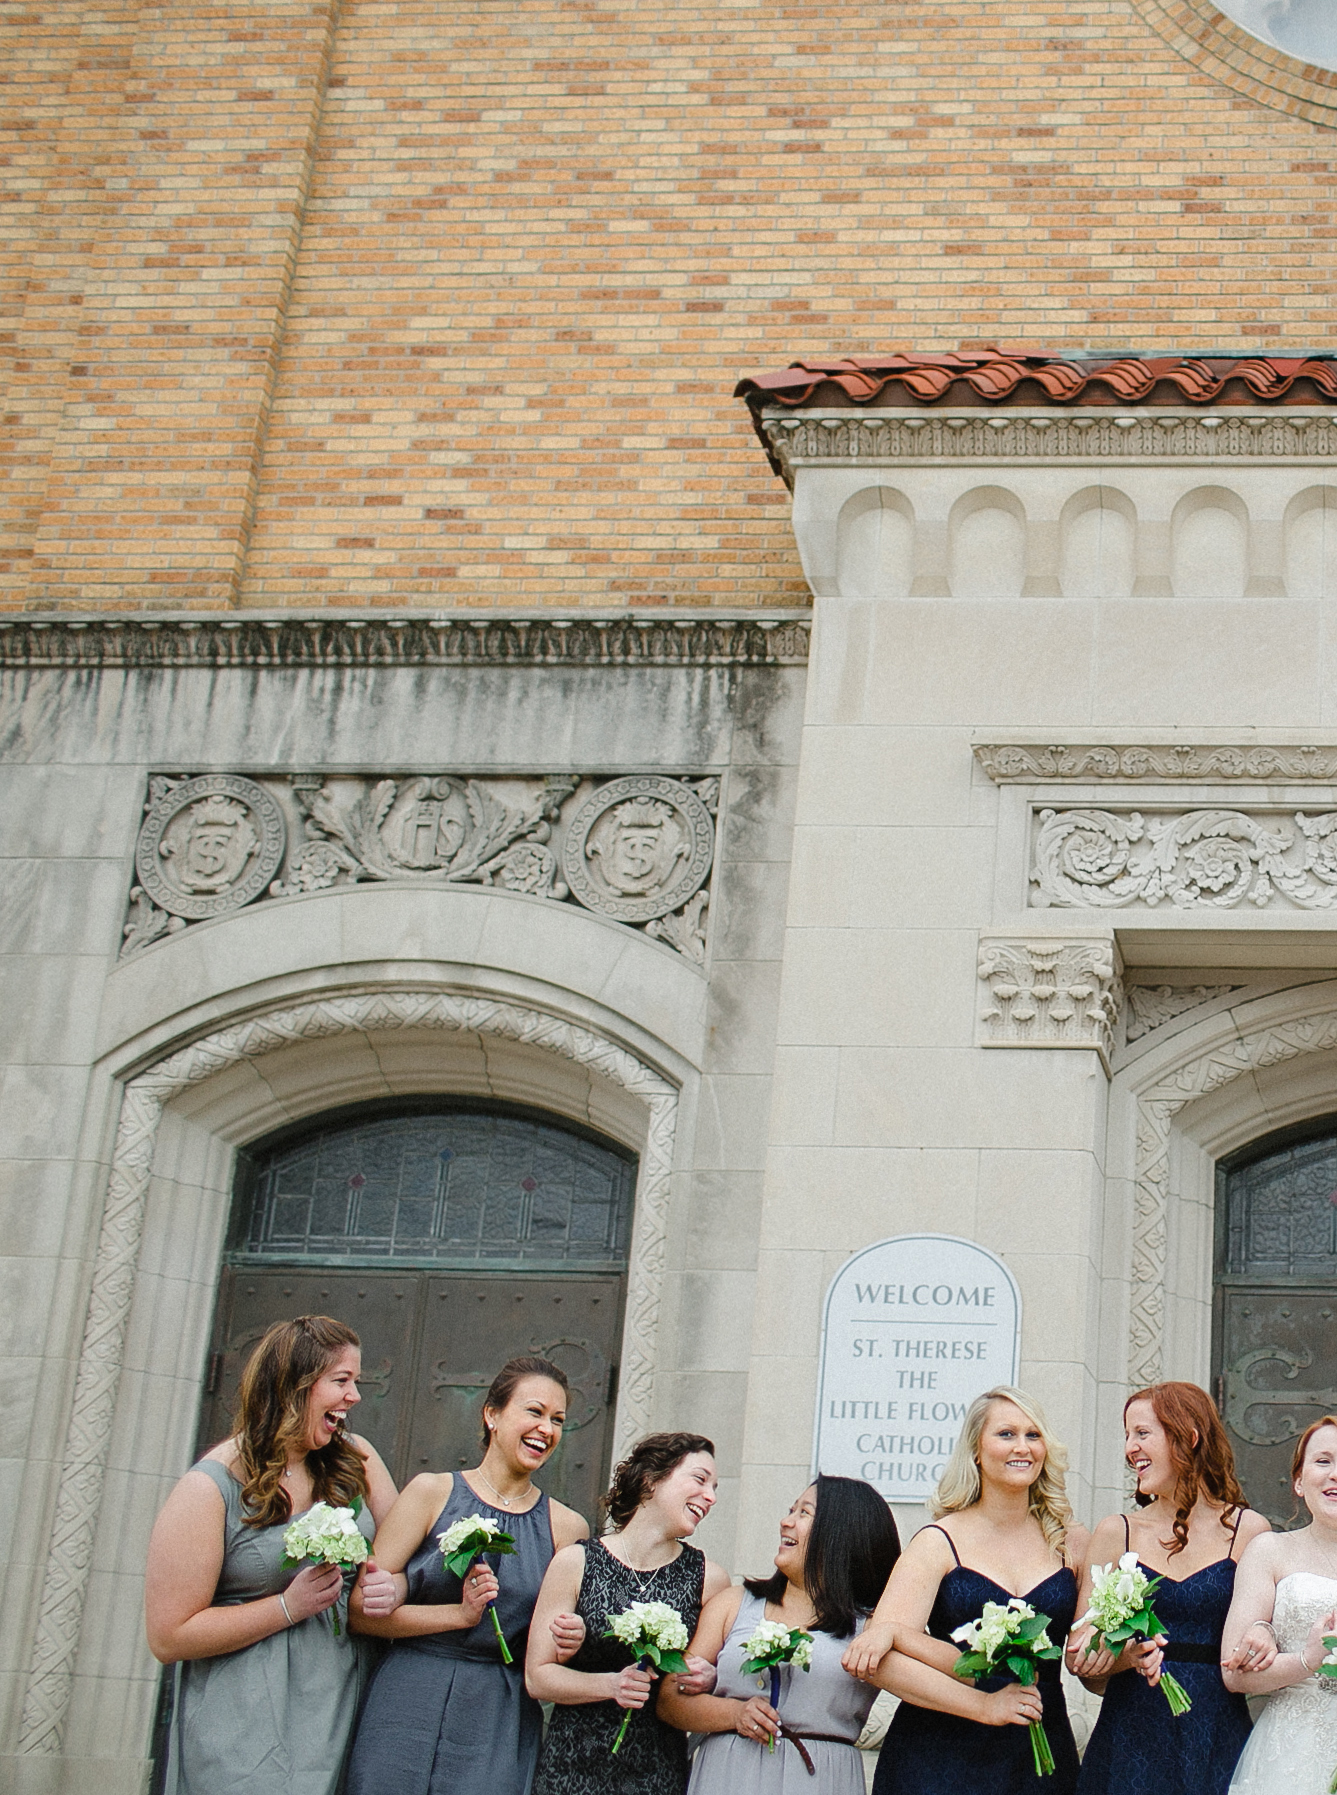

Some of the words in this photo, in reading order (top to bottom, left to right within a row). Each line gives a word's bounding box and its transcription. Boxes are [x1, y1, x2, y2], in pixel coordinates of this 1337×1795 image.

[854, 1283, 996, 1307] WELCOME
[852, 1338, 883, 1358] ST.
[893, 1339, 988, 1360] THERESE
[896, 1370, 938, 1390] THE
[830, 1400, 899, 1420] LITTLE
[908, 1402, 967, 1421] FLOW
[856, 1433, 954, 1456] CATHOLI
[861, 1461, 946, 1482] CHURC
